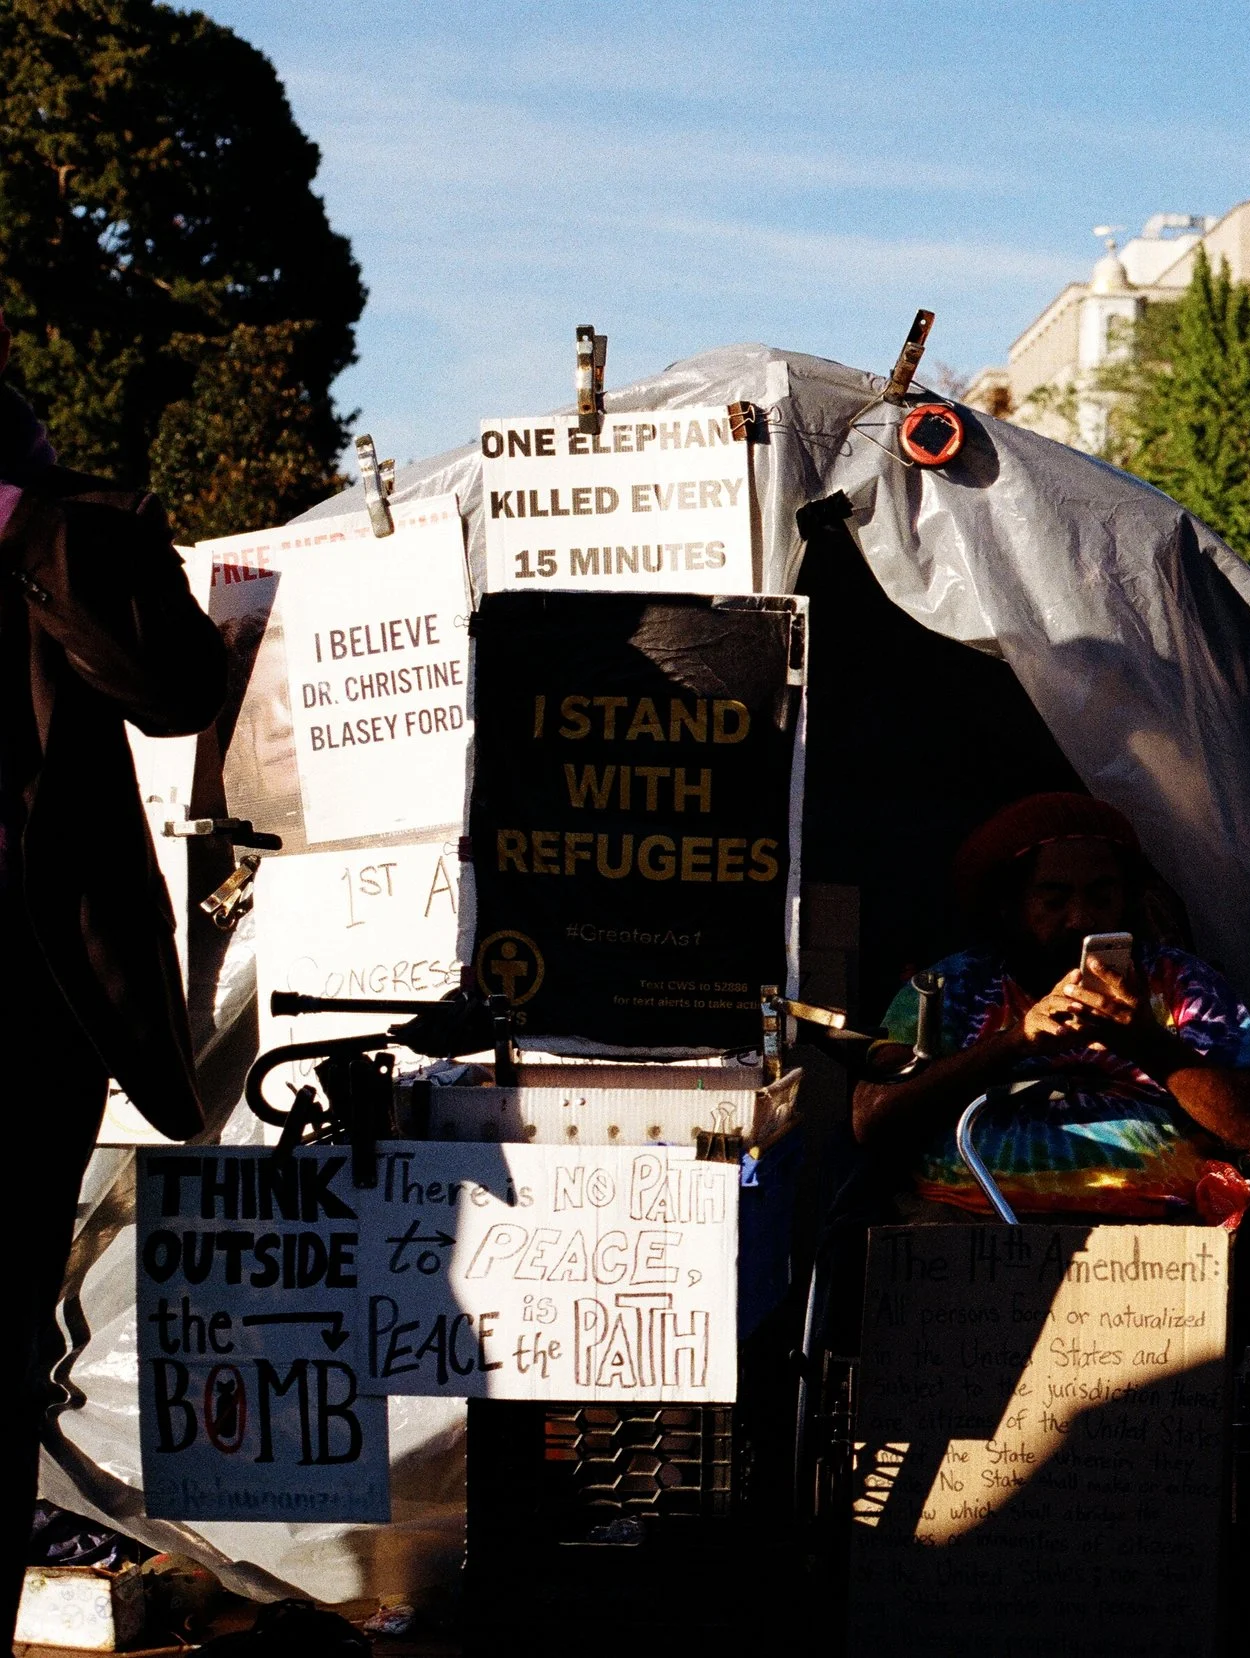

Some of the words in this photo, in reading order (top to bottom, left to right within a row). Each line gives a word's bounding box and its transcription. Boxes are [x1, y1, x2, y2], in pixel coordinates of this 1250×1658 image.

[481, 428, 557, 459] ONE
[568, 417, 731, 456] ELEPHAN
[490, 486, 620, 519] KILLED
[631, 477, 744, 513] EVERY
[514, 549, 558, 579] 15
[569, 540, 727, 577] MINUTES
[314, 633, 322, 663] I
[329, 614, 440, 660] BELIEVE
[302, 681, 340, 709] DR.
[344, 660, 463, 702] CHRISTINE
[310, 714, 398, 751] BLASEY
[404, 705, 464, 737] FORD
[532, 694, 546, 741] I
[558, 694, 751, 744] STAND
[562, 763, 712, 814] WITH
[496, 829, 780, 883] REFUGEES
[341, 862, 397, 929] 1ST
[613, 995, 630, 1005] for
[633, 996, 655, 1006] text
[658, 997, 690, 1008] alerts
[693, 999, 706, 1008] to
[708, 999, 733, 1009] take
[640, 979, 665, 990] Text
[668, 980, 696, 991] CWS
[699, 982, 711, 991] to
[147, 1156, 358, 1222] THINK
[378, 1151, 491, 1207] There
[505, 1177, 535, 1208] is
[554, 1165, 616, 1212] NO
[629, 1153, 726, 1224] PATH
[143, 1229, 358, 1289] OUTSIDE
[386, 1219, 441, 1274] to
[465, 1223, 703, 1287] PEACE,
[881, 1231, 949, 1282] The
[970, 1227, 1031, 1282] 14th
[1038, 1232, 1220, 1283] Amendment:
[148, 1296, 234, 1355] the
[522, 1294, 558, 1323] is
[920, 1307, 1000, 1337] persons
[1011, 1292, 1055, 1324] born
[1066, 1309, 1092, 1326] or
[1099, 1305, 1206, 1329] naturalized
[368, 1295, 503, 1386] PEACE
[512, 1331, 562, 1380] the
[574, 1292, 710, 1388] PATH
[912, 1338, 943, 1368] the
[960, 1338, 1034, 1369] United
[1049, 1337, 1122, 1368] States
[1131, 1339, 1169, 1366] and
[149, 1357, 364, 1467] BOMB
[960, 1375, 984, 1398] to
[1043, 1375, 1160, 1408] jurisdiction
[1006, 1407, 1030, 1430] of
[1038, 1409, 1070, 1434] the
[1086, 1411, 1148, 1443] United
[940, 1470, 964, 1492] No
[981, 1469, 1025, 1488] State
[944, 1443, 970, 1463] the
[985, 1440, 1037, 1464] State
[1149, 1451, 1195, 1480] they
[950, 1498, 998, 1520] which
